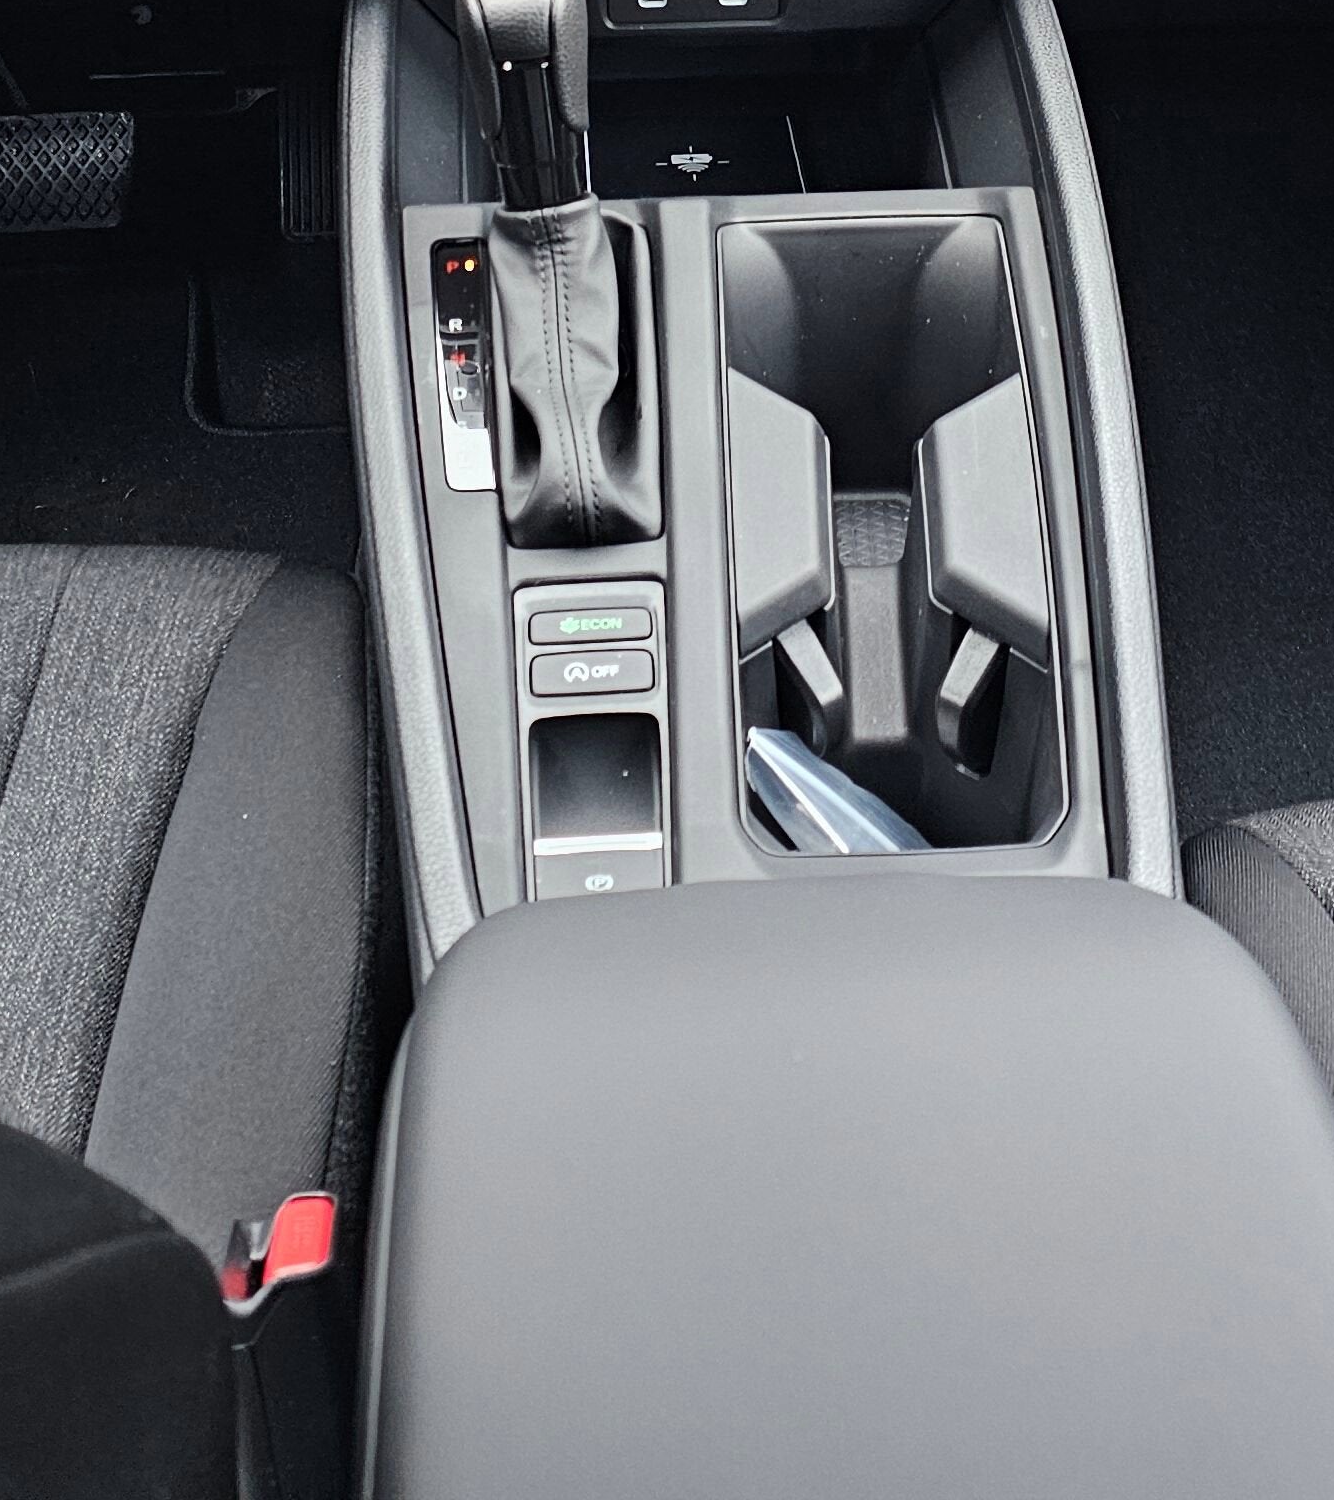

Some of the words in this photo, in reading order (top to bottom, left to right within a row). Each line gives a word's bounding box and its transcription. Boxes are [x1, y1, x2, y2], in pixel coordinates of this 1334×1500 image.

[445, 258, 460, 275] P
[448, 318, 463, 332] R
[452, 386, 468, 401] D
[580, 617, 623, 631] ECON
[590, 664, 620, 679] OFF
